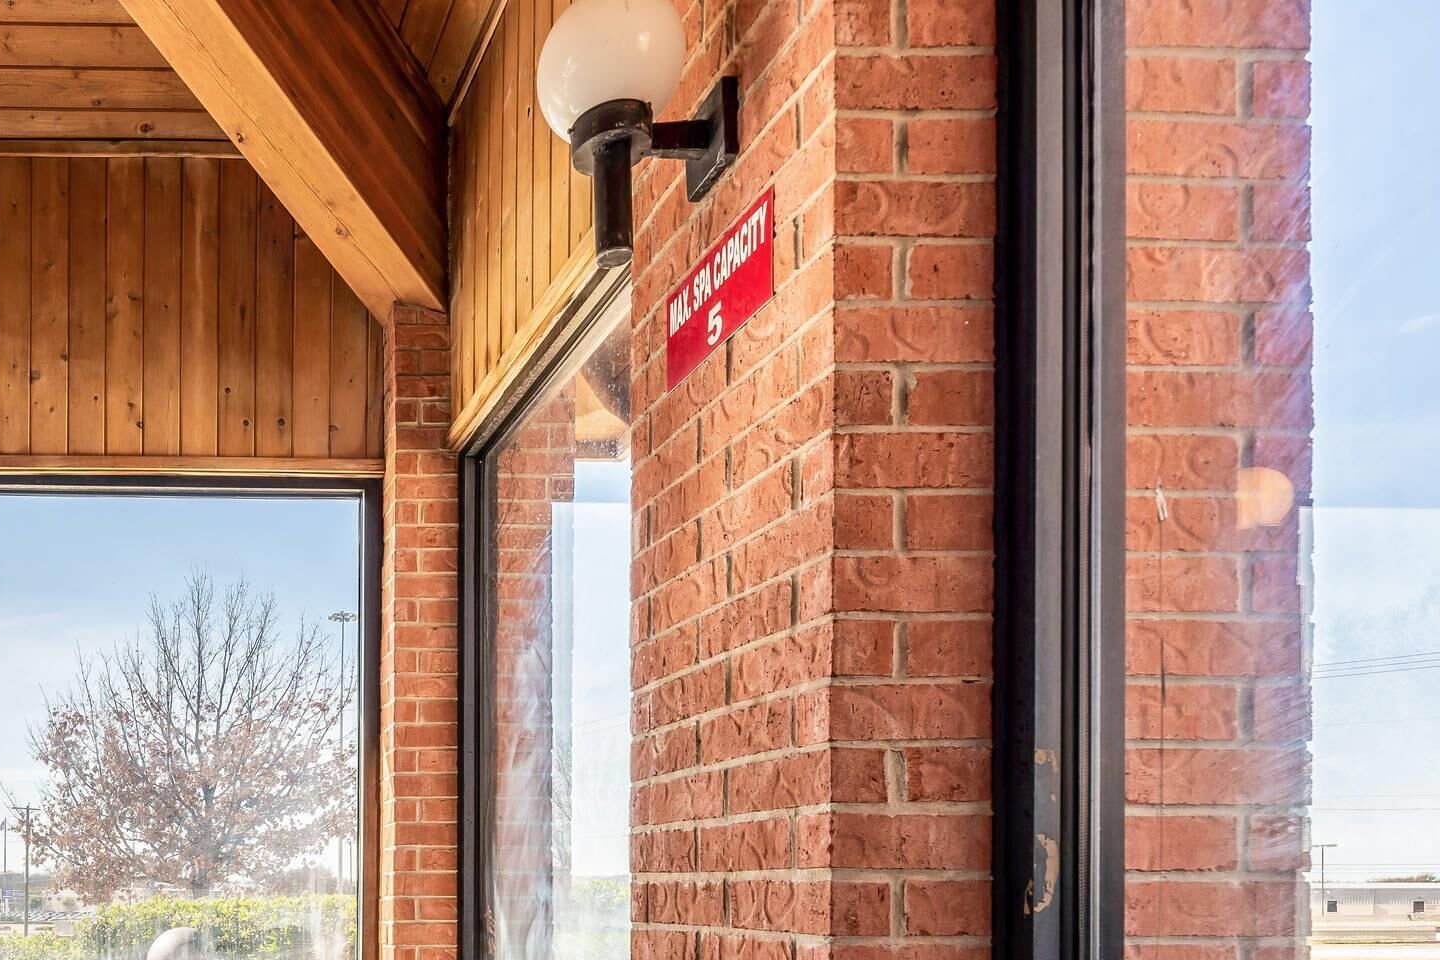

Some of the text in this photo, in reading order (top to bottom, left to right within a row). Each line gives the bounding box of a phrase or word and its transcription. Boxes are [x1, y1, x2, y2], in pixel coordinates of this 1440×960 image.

[669, 200, 768, 337] MAX. SPA CAPACITY
[707, 300, 723, 346] 5
